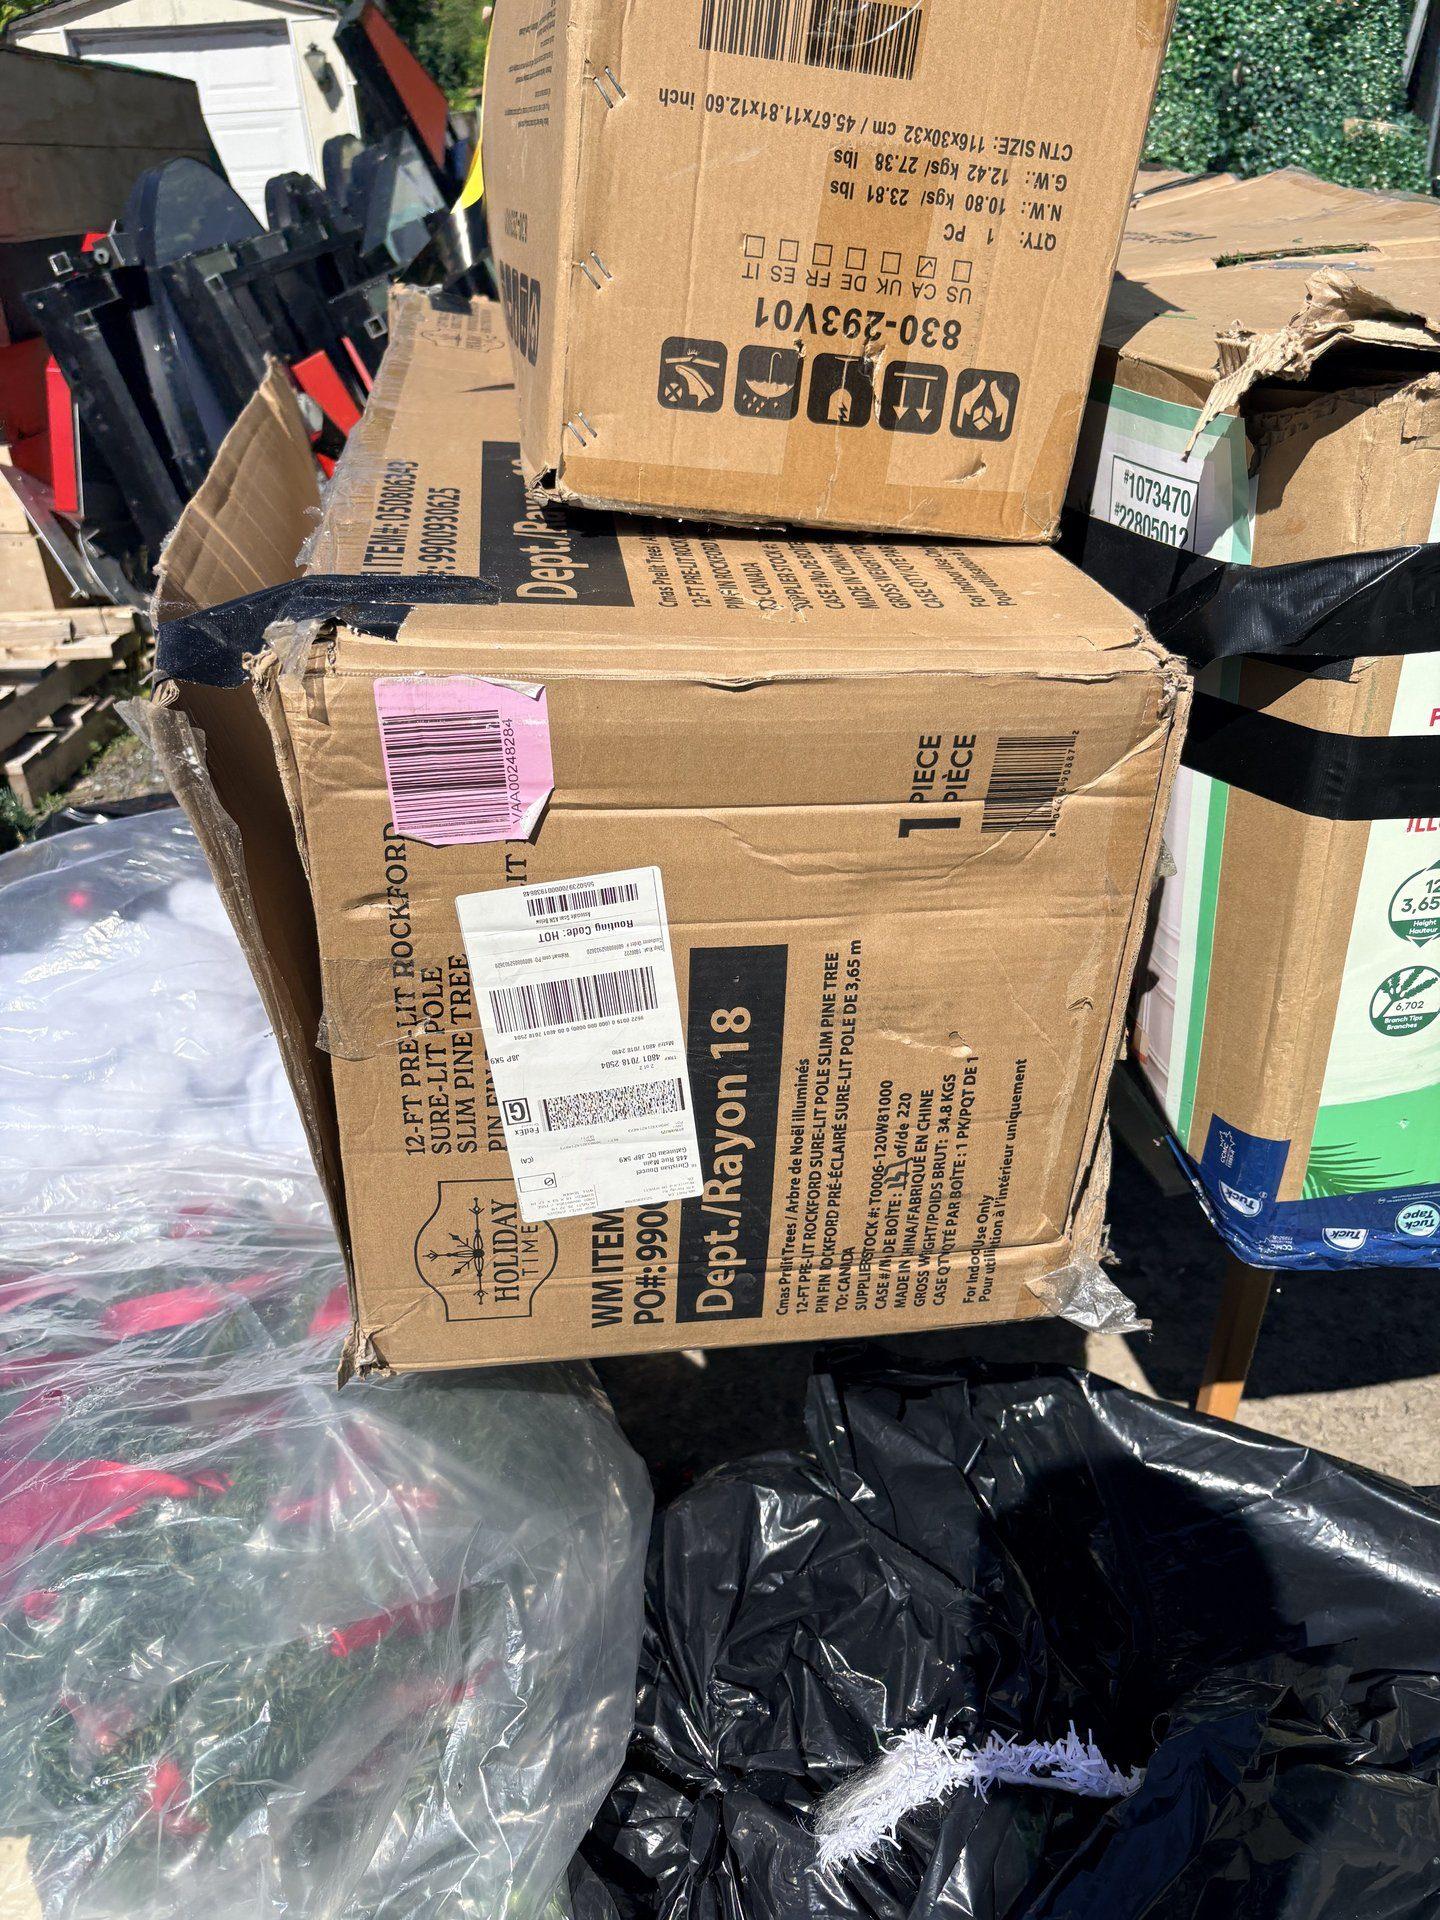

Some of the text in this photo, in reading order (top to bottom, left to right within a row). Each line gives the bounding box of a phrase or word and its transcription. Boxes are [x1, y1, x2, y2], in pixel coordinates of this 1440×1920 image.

[659, 88, 1073, 162] CTN SIZE: 116x30x32 cm / 45.67x11.81x12.60 inch
[834, 149, 1067, 192] G.W.: 12.42 kgs/ 27.38 lbs
[830, 180, 1062, 221] N.W.: 10.80 kgs/ 23.81 lbs
[944, 223, 1056, 251] QTY: 1 PC
[742, 262, 972, 304] US CA UK DE FR ES IT
[754, 298, 962, 350] 830-293V01
[375, 460, 418, 520] 050806343
[1124, 470, 1191, 518] #1073470
[418, 487, 460, 562] 9900930625
[1114, 502, 1188, 549] #22805012
[645, 546, 664, 563] Trees
[701, 542, 732, 579] ROCKFORD
[885, 558, 927, 588] QTY/QTÉ
[650, 564, 672, 585] Prelit
[676, 558, 712, 607] 12-FT PRE-LIT
[741, 562, 772, 595] CANADA
[768, 549, 813, 611] SUPPLIER STOCK
[804, 560, 846, 609] CASE DE
[933, 558, 990, 608] For Indoor Use
[957, 557, 1017, 606] Pour utilisation
[658, 587, 678, 607] Cmas
[847, 586, 880, 609] MADE
[877, 583, 911, 609] GROSS
[919, 588, 944, 609] CASE
[502, 718, 522, 824] VAA00248284
[909, 735, 942, 802] PIECE
[942, 734, 976, 802] PIÈCE
[898, 817, 961, 838] 1
[538, 920, 633, 942] Routing Code: HOT
[1409, 926, 1438, 935] Hauteur
[1413, 918, 1437, 928] Height
[850, 940, 861, 955] m
[845, 959, 861, 991] 3,65
[843, 994, 857, 1014] DE
[1384, 1016, 1408, 1024] Branch
[1396, 1000, 1424, 1012] 6,702
[393, 987, 421, 1086] PRE-LIT
[448, 953, 477, 1153] SLIM PINE TREE
[840, 1018, 856, 1055] POLE
[420, 966, 451, 1154] SURE-LIT POLE
[489, 1054, 520, 1065] J8P 5K9
[601, 1053, 660, 1069] 4801 7018 2504
[963, 1067, 977, 1086] DE
[835, 1059, 852, 1120] SURE-LIT
[402, 1094, 425, 1156] 12-FT
[509, 1102, 526, 1120] G
[957, 1089, 976, 1139] PK/PQT
[487, 1115, 508, 1152] PIN
[514, 1127, 540, 1136] FedEx
[796, 952, 838, 1314] 12-FT ROCKFORD SURE-LIT POLE SLIM PINE TREE
[868, 1080, 893, 1205] T0006-120W81000
[520, 1156, 534, 1164] (CA)
[661, 1156, 674, 1164] Rue
[694, 1007, 755, 1314] Dept./Rayon 18
[826, 1124, 846, 1206] PRÉ-ÉCLAIRÉ
[950, 1160, 966, 1198] BOÎTE
[776, 1058, 810, 1315] Cmas Trees Arbre de Noël illuminés
[894, 1089, 934, 1308] MADE IN EN CHINE
[914, 1074, 956, 1307] GROSS BRUT: 34.8 KGS
[978, 1275, 994, 1302] Pour
[1004, 1059, 1027, 1141] uniquement
[1225, 1188, 1254, 1209] Tuck
[875, 1093, 912, 1309] CASE DE BOÎTE of/de 220
[945, 1202, 961, 1226] PAR
[1402, 1210, 1434, 1220] Tape
[1330, 1230, 1362, 1240] Tuck
[1405, 1219, 1435, 1229] Tuck
[491, 1199, 519, 1302] HOLIDAY
[521, 1225, 539, 1276] TIME
[963, 1195, 993, 1304] For Use Only
[818, 1274, 831, 1293] FIN
[835, 1246, 855, 1312] TO: CANADA
[933, 1278, 948, 1306] CASE
[591, 1279, 624, 1328] WM
[815, 1295, 828, 1313] PIN
